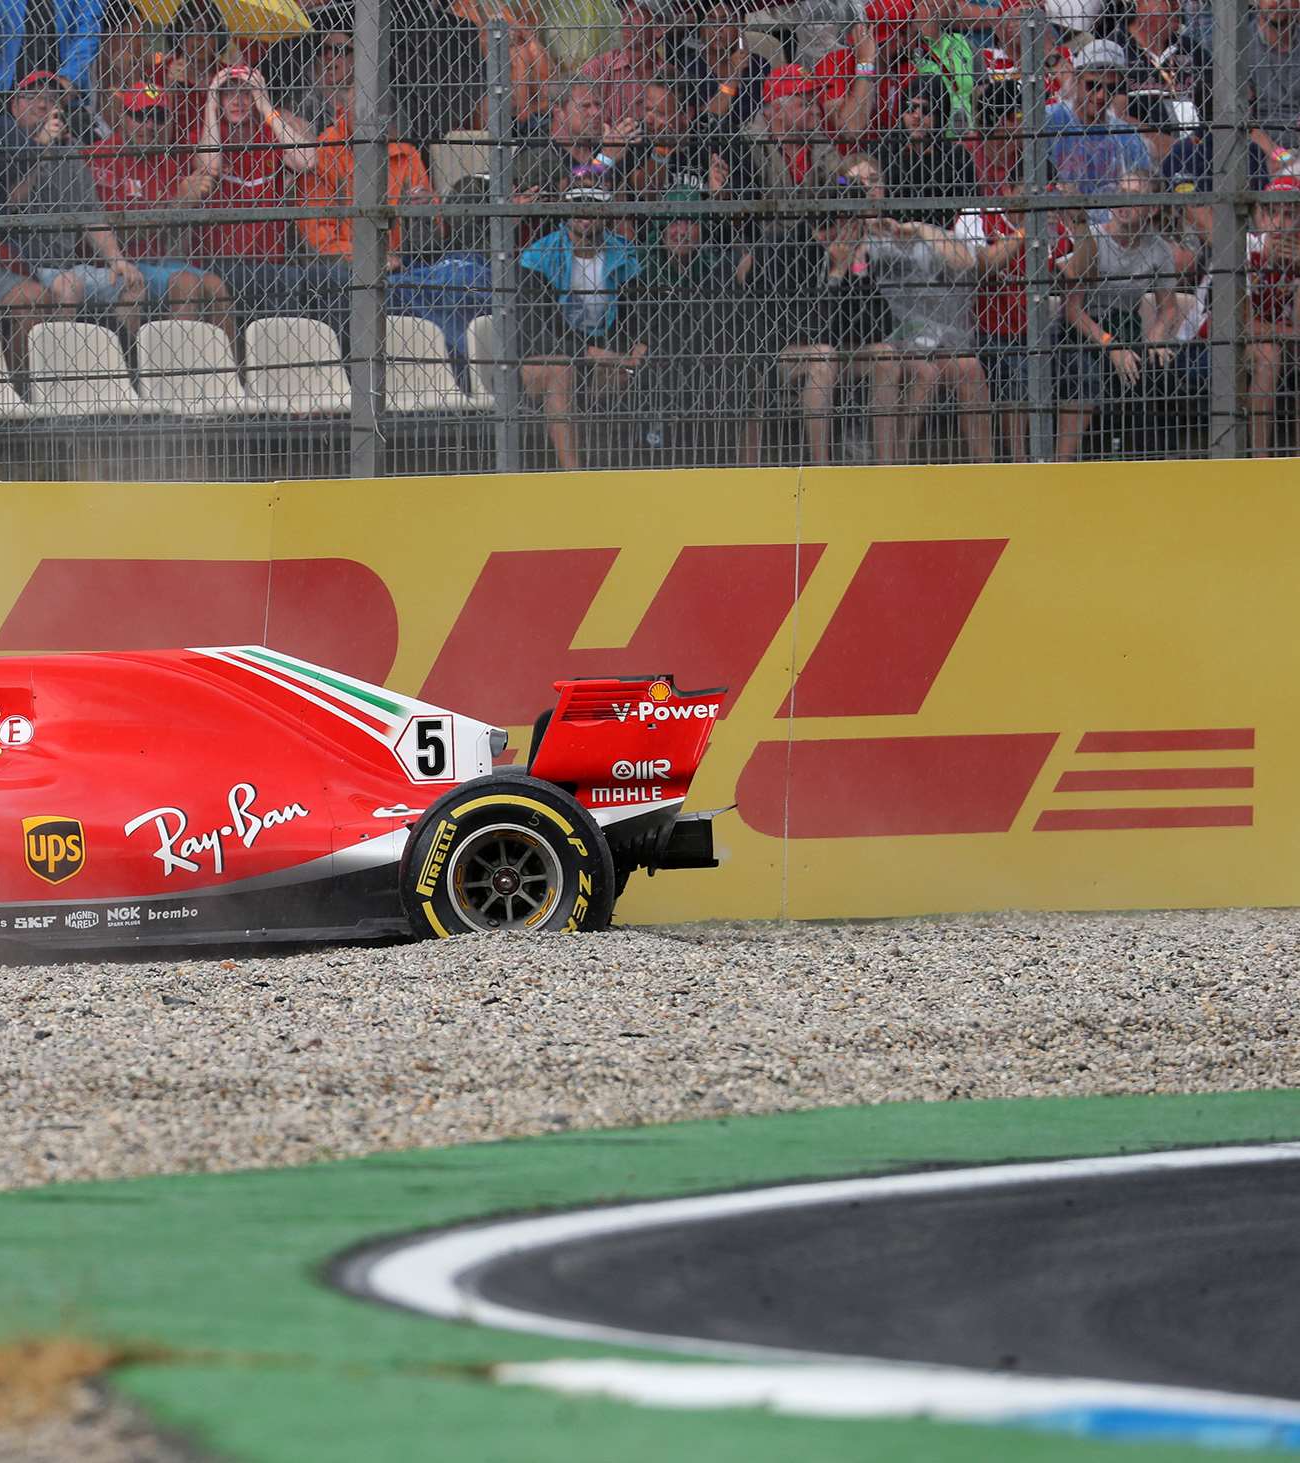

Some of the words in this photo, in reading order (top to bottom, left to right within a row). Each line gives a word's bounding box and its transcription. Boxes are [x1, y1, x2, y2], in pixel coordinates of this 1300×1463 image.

[611, 702, 719, 722] V-Power
[8, 719, 21, 743] E
[415, 720, 446, 777] 5
[592, 786, 663, 802] MAHLE
[567, 837, 588, 857] P
[416, 819, 458, 898] PIRELLI
[14, 916, 58, 930] SKF
[107, 906, 141, 922] NGK
[148, 906, 199, 921] brembo
